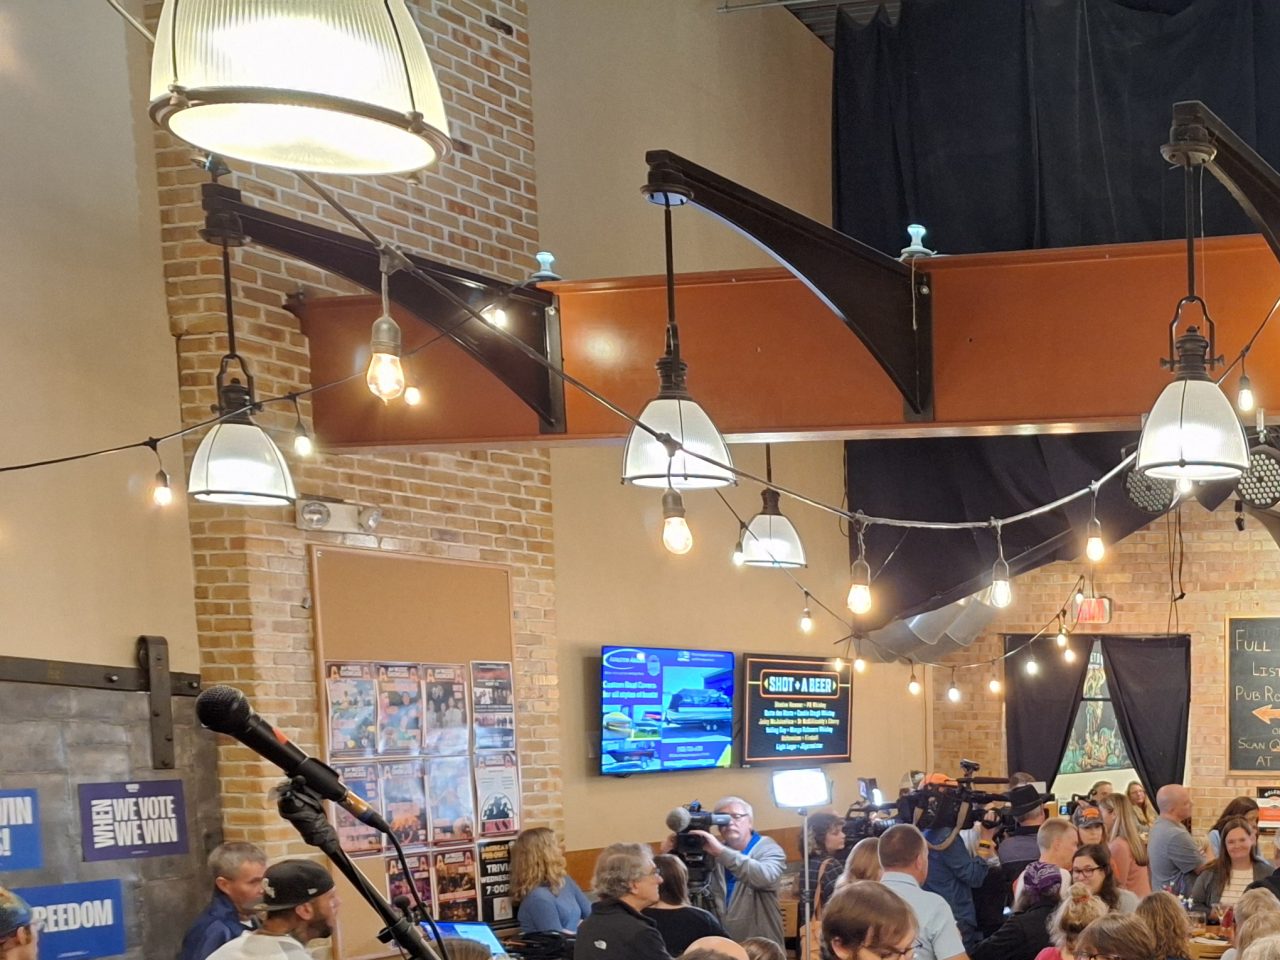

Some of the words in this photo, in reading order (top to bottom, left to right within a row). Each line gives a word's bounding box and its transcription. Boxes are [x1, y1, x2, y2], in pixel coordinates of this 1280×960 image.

[1235, 629, 1271, 652] FULL
[769, 676, 795, 692] SHOT
[801, 677, 808, 692] A
[809, 678, 832, 693] BEER
[1235, 686, 1261, 701] PUB
[1238, 738, 1266, 750] SCAN
[1256, 756, 1272, 767] AT
[113, 798, 139, 821] WE
[138, 796, 177, 820] VOTE
[91, 799, 115, 849] WHEN
[114, 820, 143, 847] WE
[142, 818, 179, 844] WIN
[486, 863, 511, 874] TRIVI
[486, 884, 511, 895] 7:00P
[32, 898, 115, 933] REEDOM
